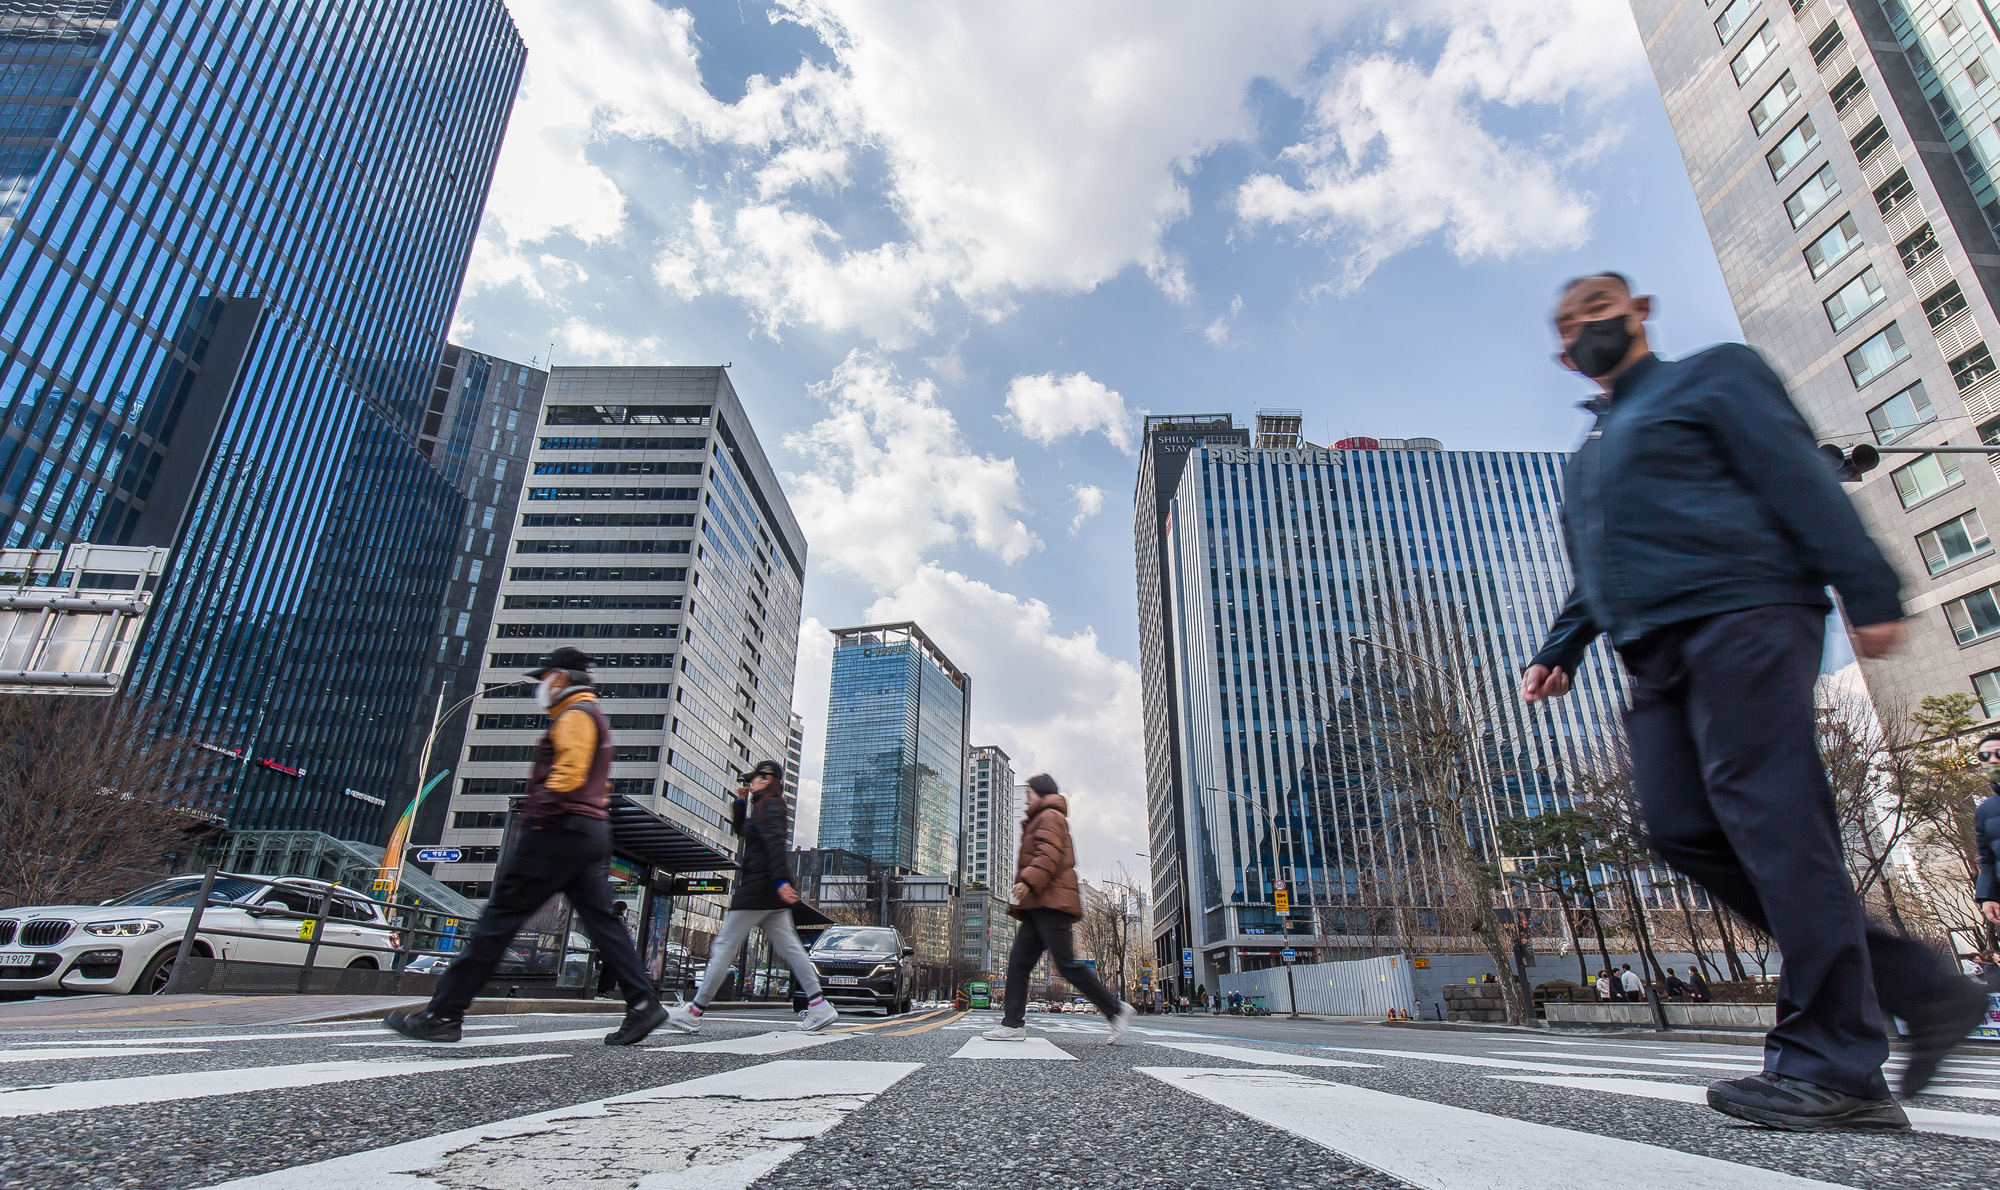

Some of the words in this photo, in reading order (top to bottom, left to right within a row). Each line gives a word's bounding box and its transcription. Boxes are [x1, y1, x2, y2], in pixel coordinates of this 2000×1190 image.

[1158, 436, 1195, 444] SHILLA
[1165, 445, 1189, 453] STAY
[1208, 449, 1262, 465] POST
[1266, 449, 1344, 466] TOWER
[6, 954, 31, 965] 1907
